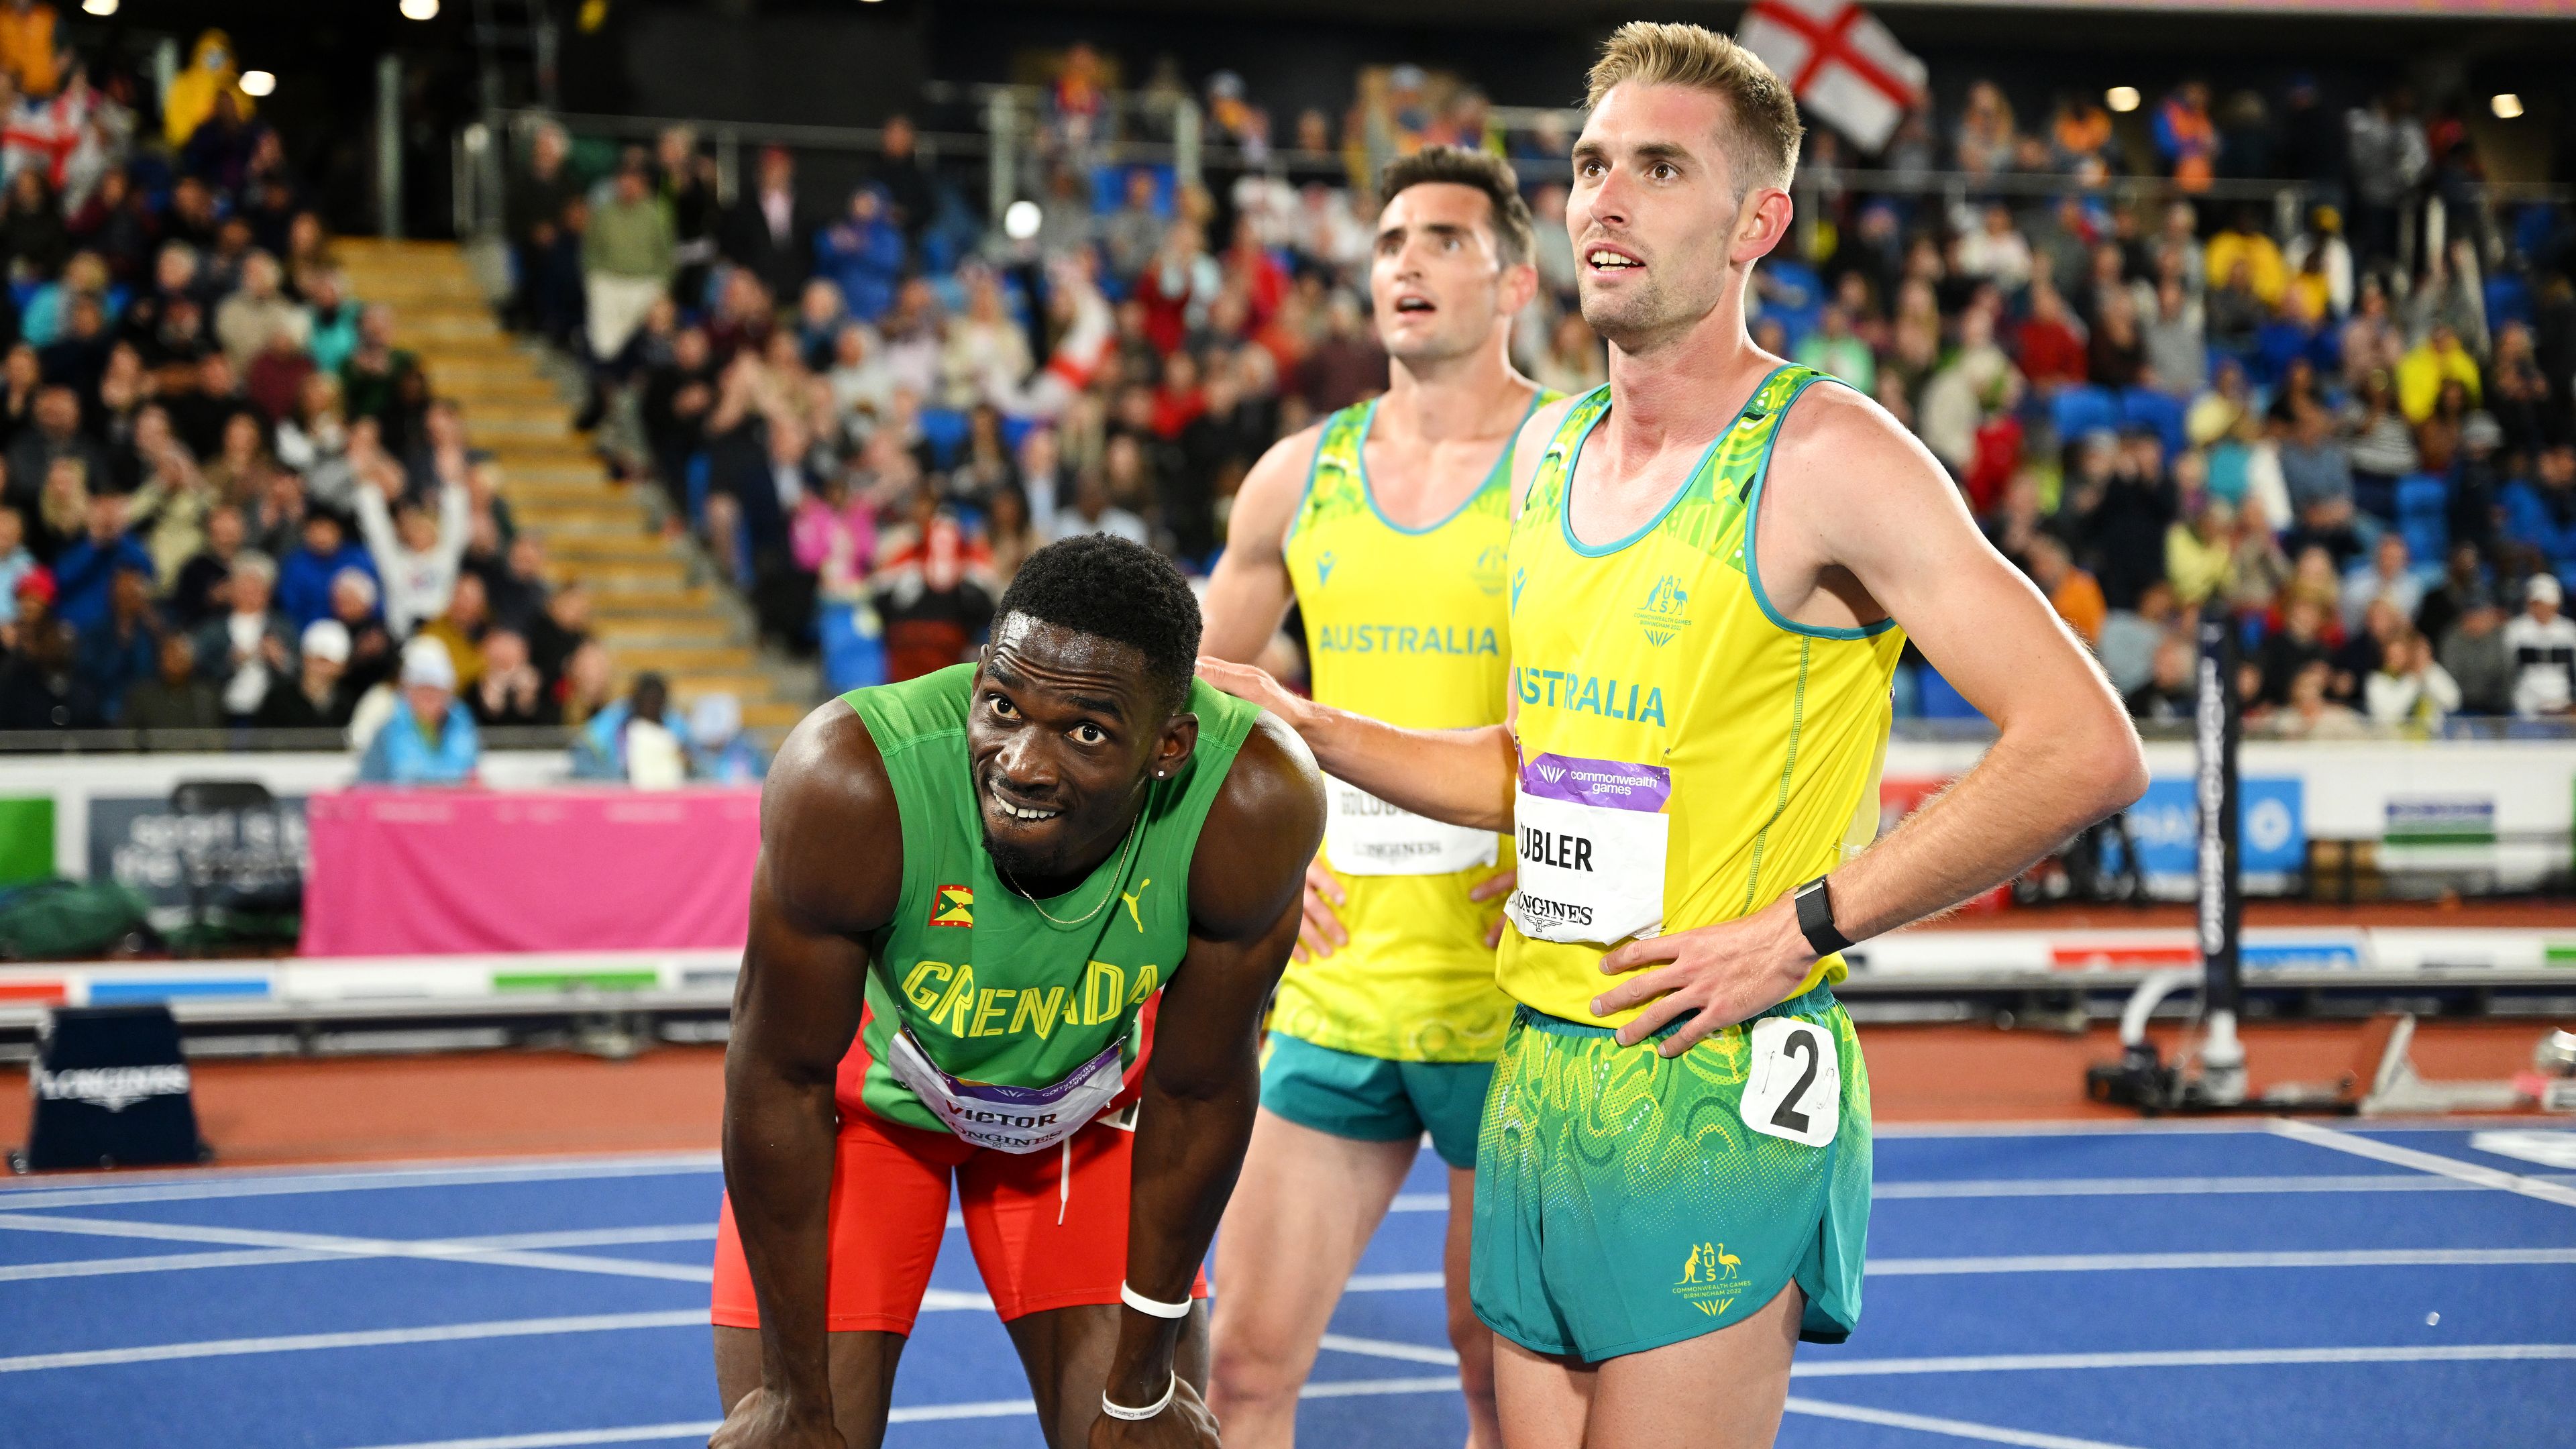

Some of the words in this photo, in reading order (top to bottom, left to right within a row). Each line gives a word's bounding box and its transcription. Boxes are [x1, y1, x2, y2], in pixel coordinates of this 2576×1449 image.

[1659, 575, 1674, 613] AUS
[1633, 612, 1674, 623] COMMONWEALTH
[1674, 618, 1692, 626] GAMES
[1640, 619, 1670, 629] BIRMINGHAM
[1320, 623, 1499, 657] AUSTRALIA
[1514, 667, 1666, 727] USTRALIA
[1570, 769, 1658, 788] commonwealth
[1592, 783, 1631, 796] games
[902, 960, 1159, 1040] GRENADA
[1770, 1029, 1819, 1134] 2
[945, 1099, 1057, 1128] VICTOR
[1703, 1242, 1717, 1282] AUS
[1672, 1283, 1729, 1293] COMMONWEALTH
[1683, 1291, 1725, 1299] BIRMINGHAM
